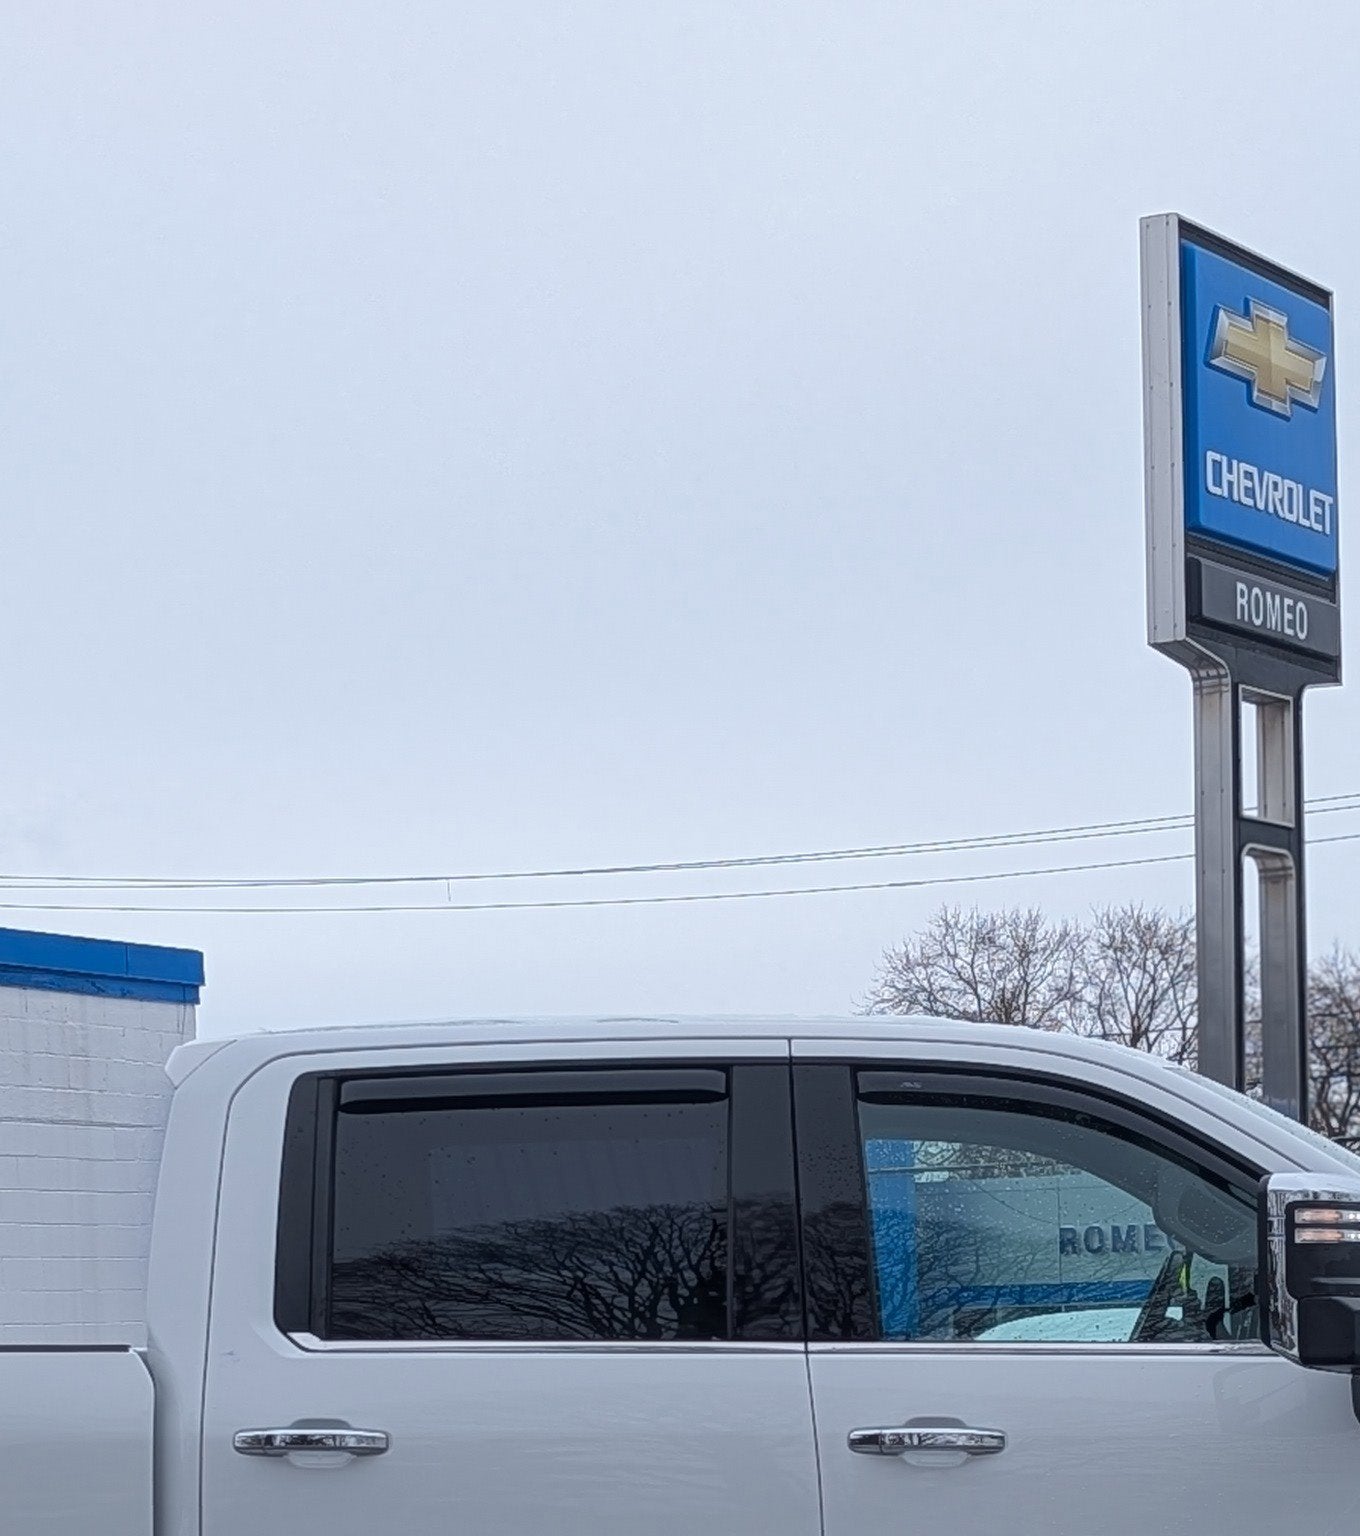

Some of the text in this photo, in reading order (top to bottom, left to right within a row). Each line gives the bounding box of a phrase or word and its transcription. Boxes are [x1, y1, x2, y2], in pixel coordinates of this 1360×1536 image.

[1206, 451, 1334, 535] CHEVROLET
[1236, 581, 1308, 640] ROMEO
[1059, 1224, 1175, 1254] ROME
